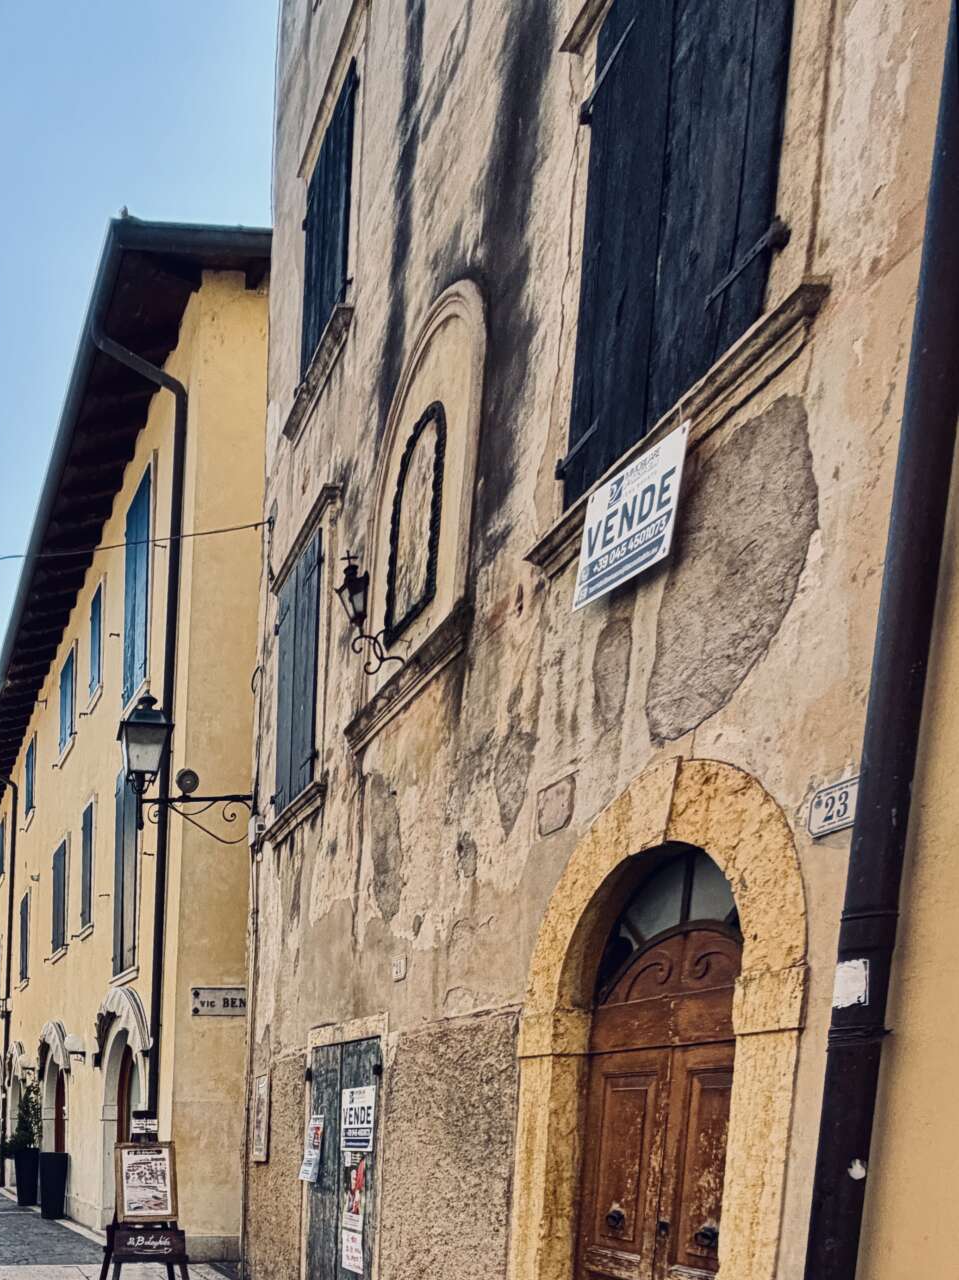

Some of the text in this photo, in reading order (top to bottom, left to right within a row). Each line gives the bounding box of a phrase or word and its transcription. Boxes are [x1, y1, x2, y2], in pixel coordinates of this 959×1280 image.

[587, 465, 676, 559] VENDE
[592, 554, 609, 574] +39
[608, 542, 628, 564] 045
[823, 790, 849, 823] 23
[343, 1106, 372, 1125] VENDE
